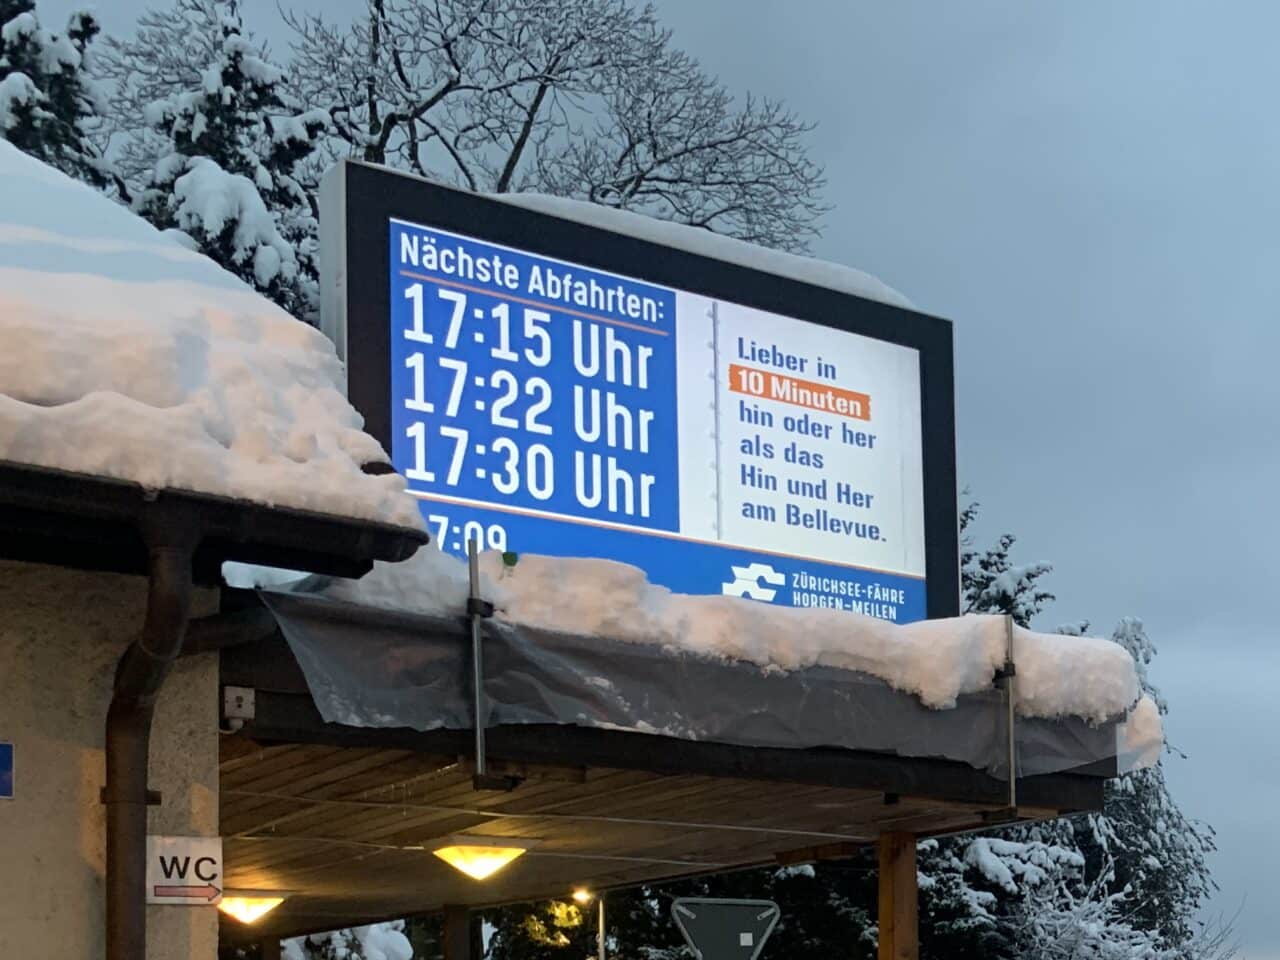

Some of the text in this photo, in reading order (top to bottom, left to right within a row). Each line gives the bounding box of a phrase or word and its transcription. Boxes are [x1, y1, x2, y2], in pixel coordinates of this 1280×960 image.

[401, 232, 664, 322] Nächste Abfahrten:
[403, 283, 653, 389] 17:15 Uhr
[738, 337, 837, 380] Lieber in
[404, 352, 654, 453] 17:22 Uhr
[738, 369, 861, 417] 10 Minuten
[740, 400, 876, 449] hin oder her
[405, 421, 655, 517] 17:30 Uhr
[740, 434, 824, 469] als das
[741, 464, 874, 508] Hin und Her
[428, 514, 507, 557] 7:09
[741, 502, 887, 542] am Bellevue.
[792, 571, 905, 604] ZÜRICHSEE-FÄHRE
[159, 855, 218, 882] WC
